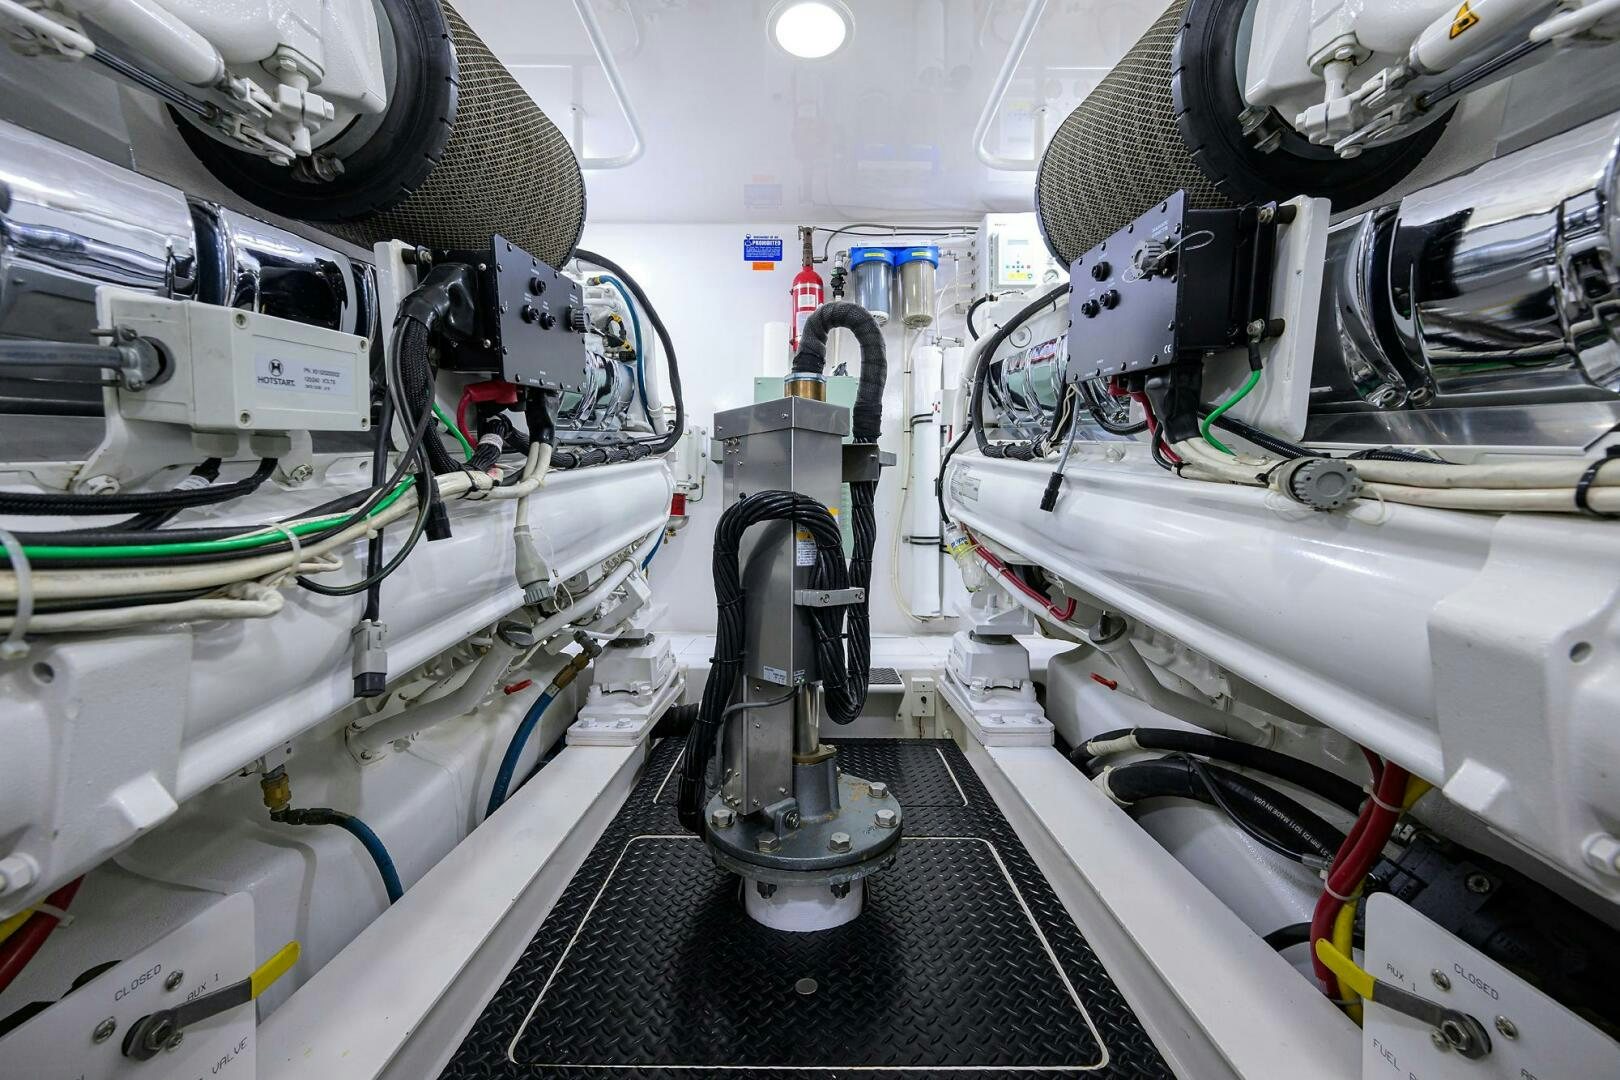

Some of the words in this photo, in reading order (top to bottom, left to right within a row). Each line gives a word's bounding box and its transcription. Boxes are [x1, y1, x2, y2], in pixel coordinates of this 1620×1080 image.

[257, 376, 296, 387] HOTSTART
[114, 963, 162, 1001] CLOSED
[1386, 963, 1404, 982] AUX
[1454, 963, 1499, 1000] CLOSED
[186, 981, 207, 1001] AUX
[212, 1036, 249, 1074] VALVE
[1373, 1038, 1401, 1071] FUEL
